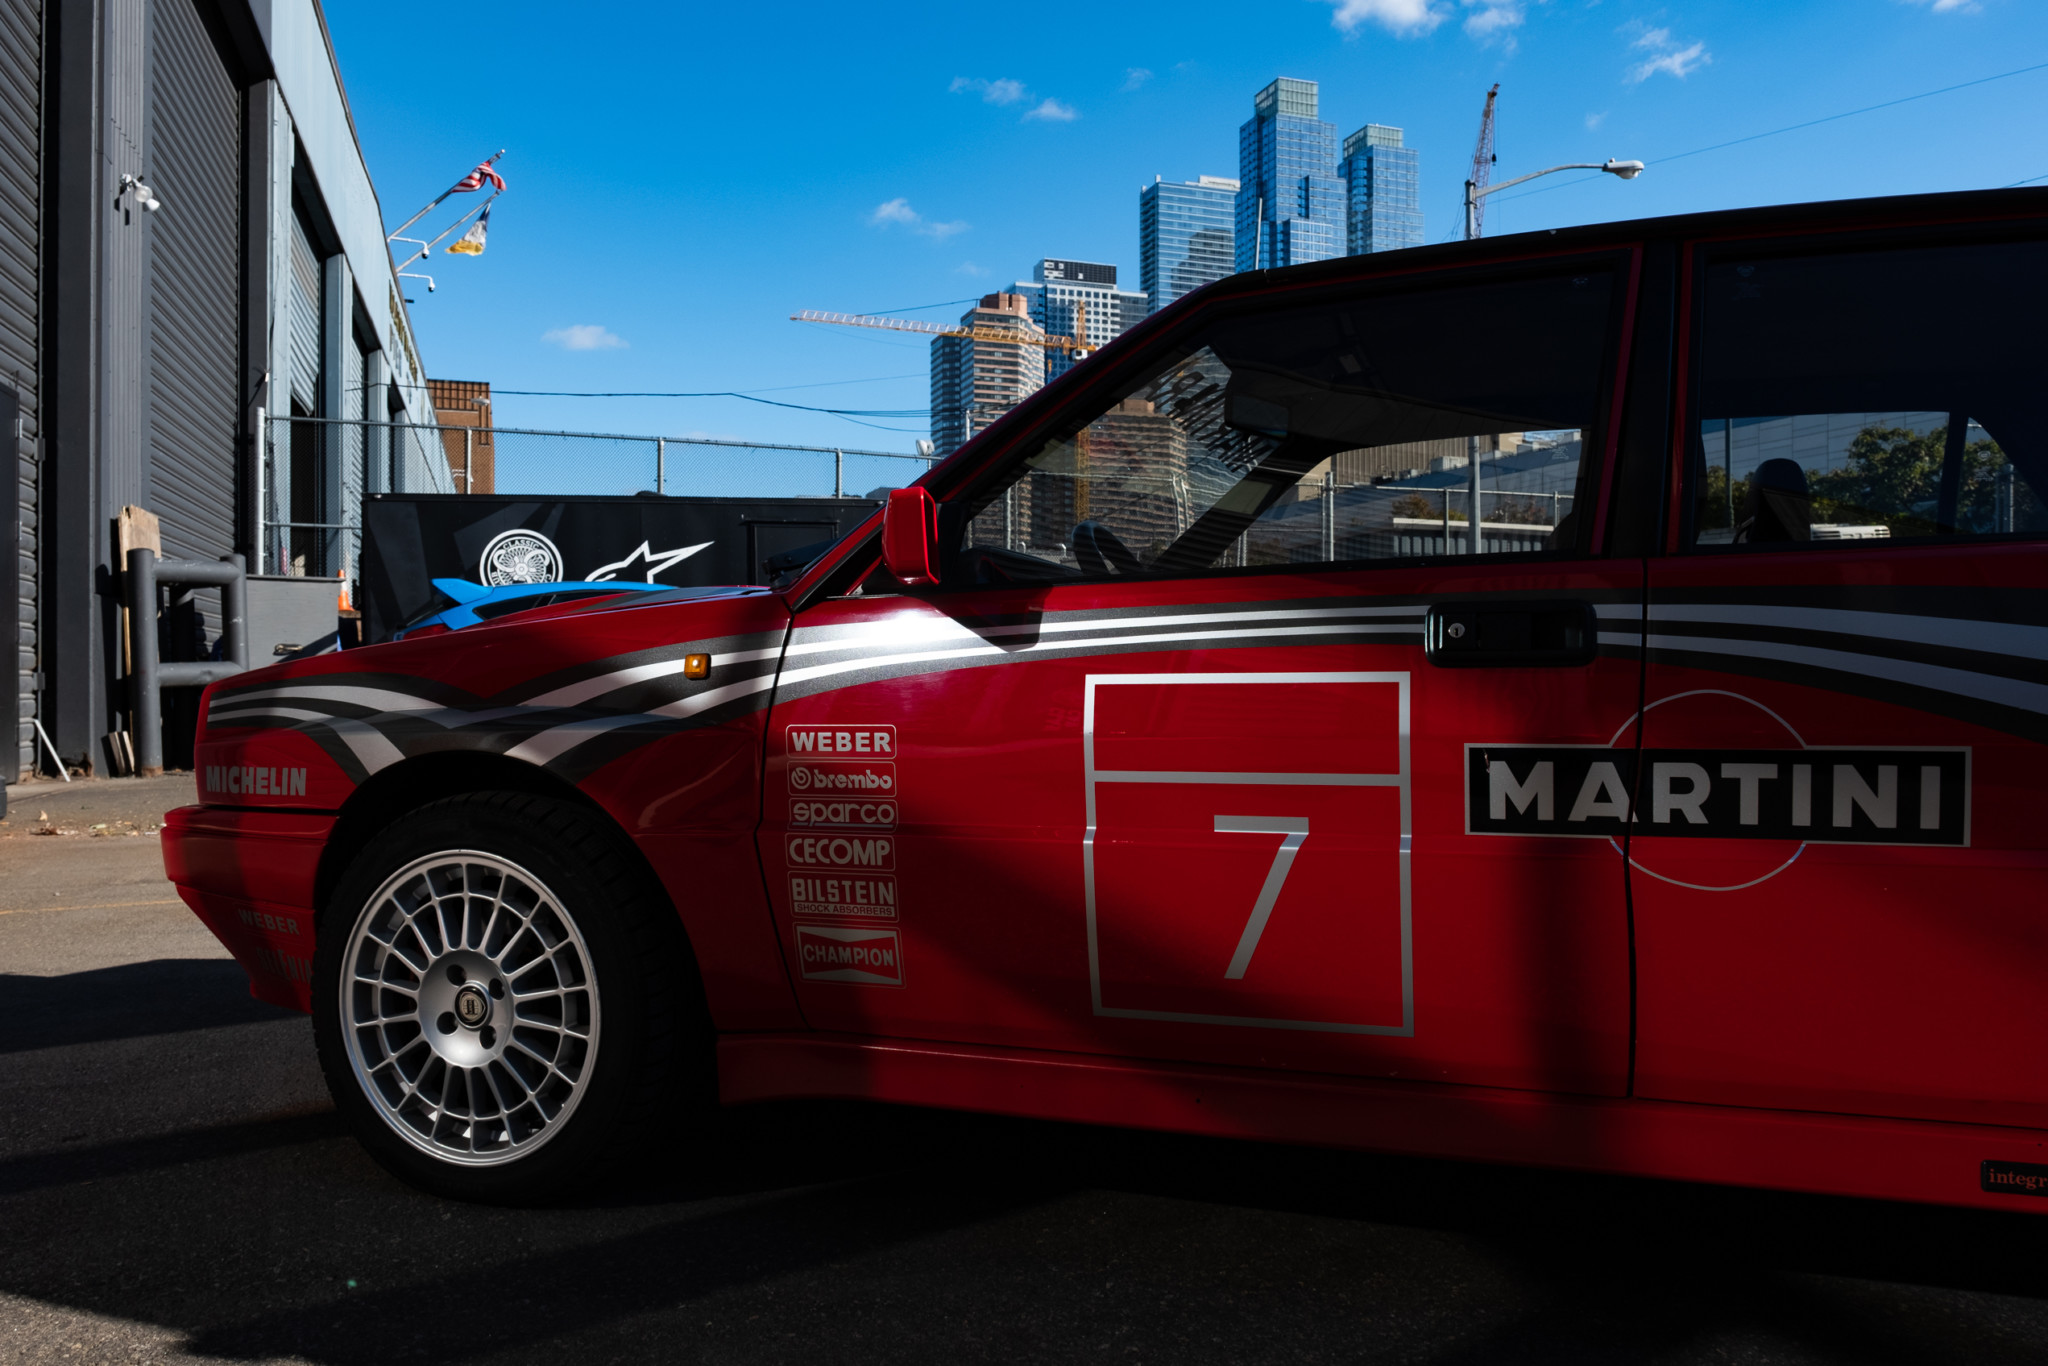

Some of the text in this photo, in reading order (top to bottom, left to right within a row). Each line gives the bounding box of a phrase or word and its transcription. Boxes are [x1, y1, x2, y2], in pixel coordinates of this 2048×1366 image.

[503, 539, 540, 550] CLASSIC
[791, 731, 892, 752] WEBER
[205, 765, 307, 796] MICHELIN
[813, 768, 893, 790] brembo
[1488, 760, 1942, 830] MARTINI
[793, 802, 895, 827] sparco
[789, 837, 891, 866] CECOMP
[791, 878, 895, 905] BILSTEIN
[1213, 815, 1310, 980] 7
[237, 907, 300, 935] WEBER
[797, 903, 893, 916] SHOCK ABSORBERS
[803, 943, 895, 967] CHAMPION
